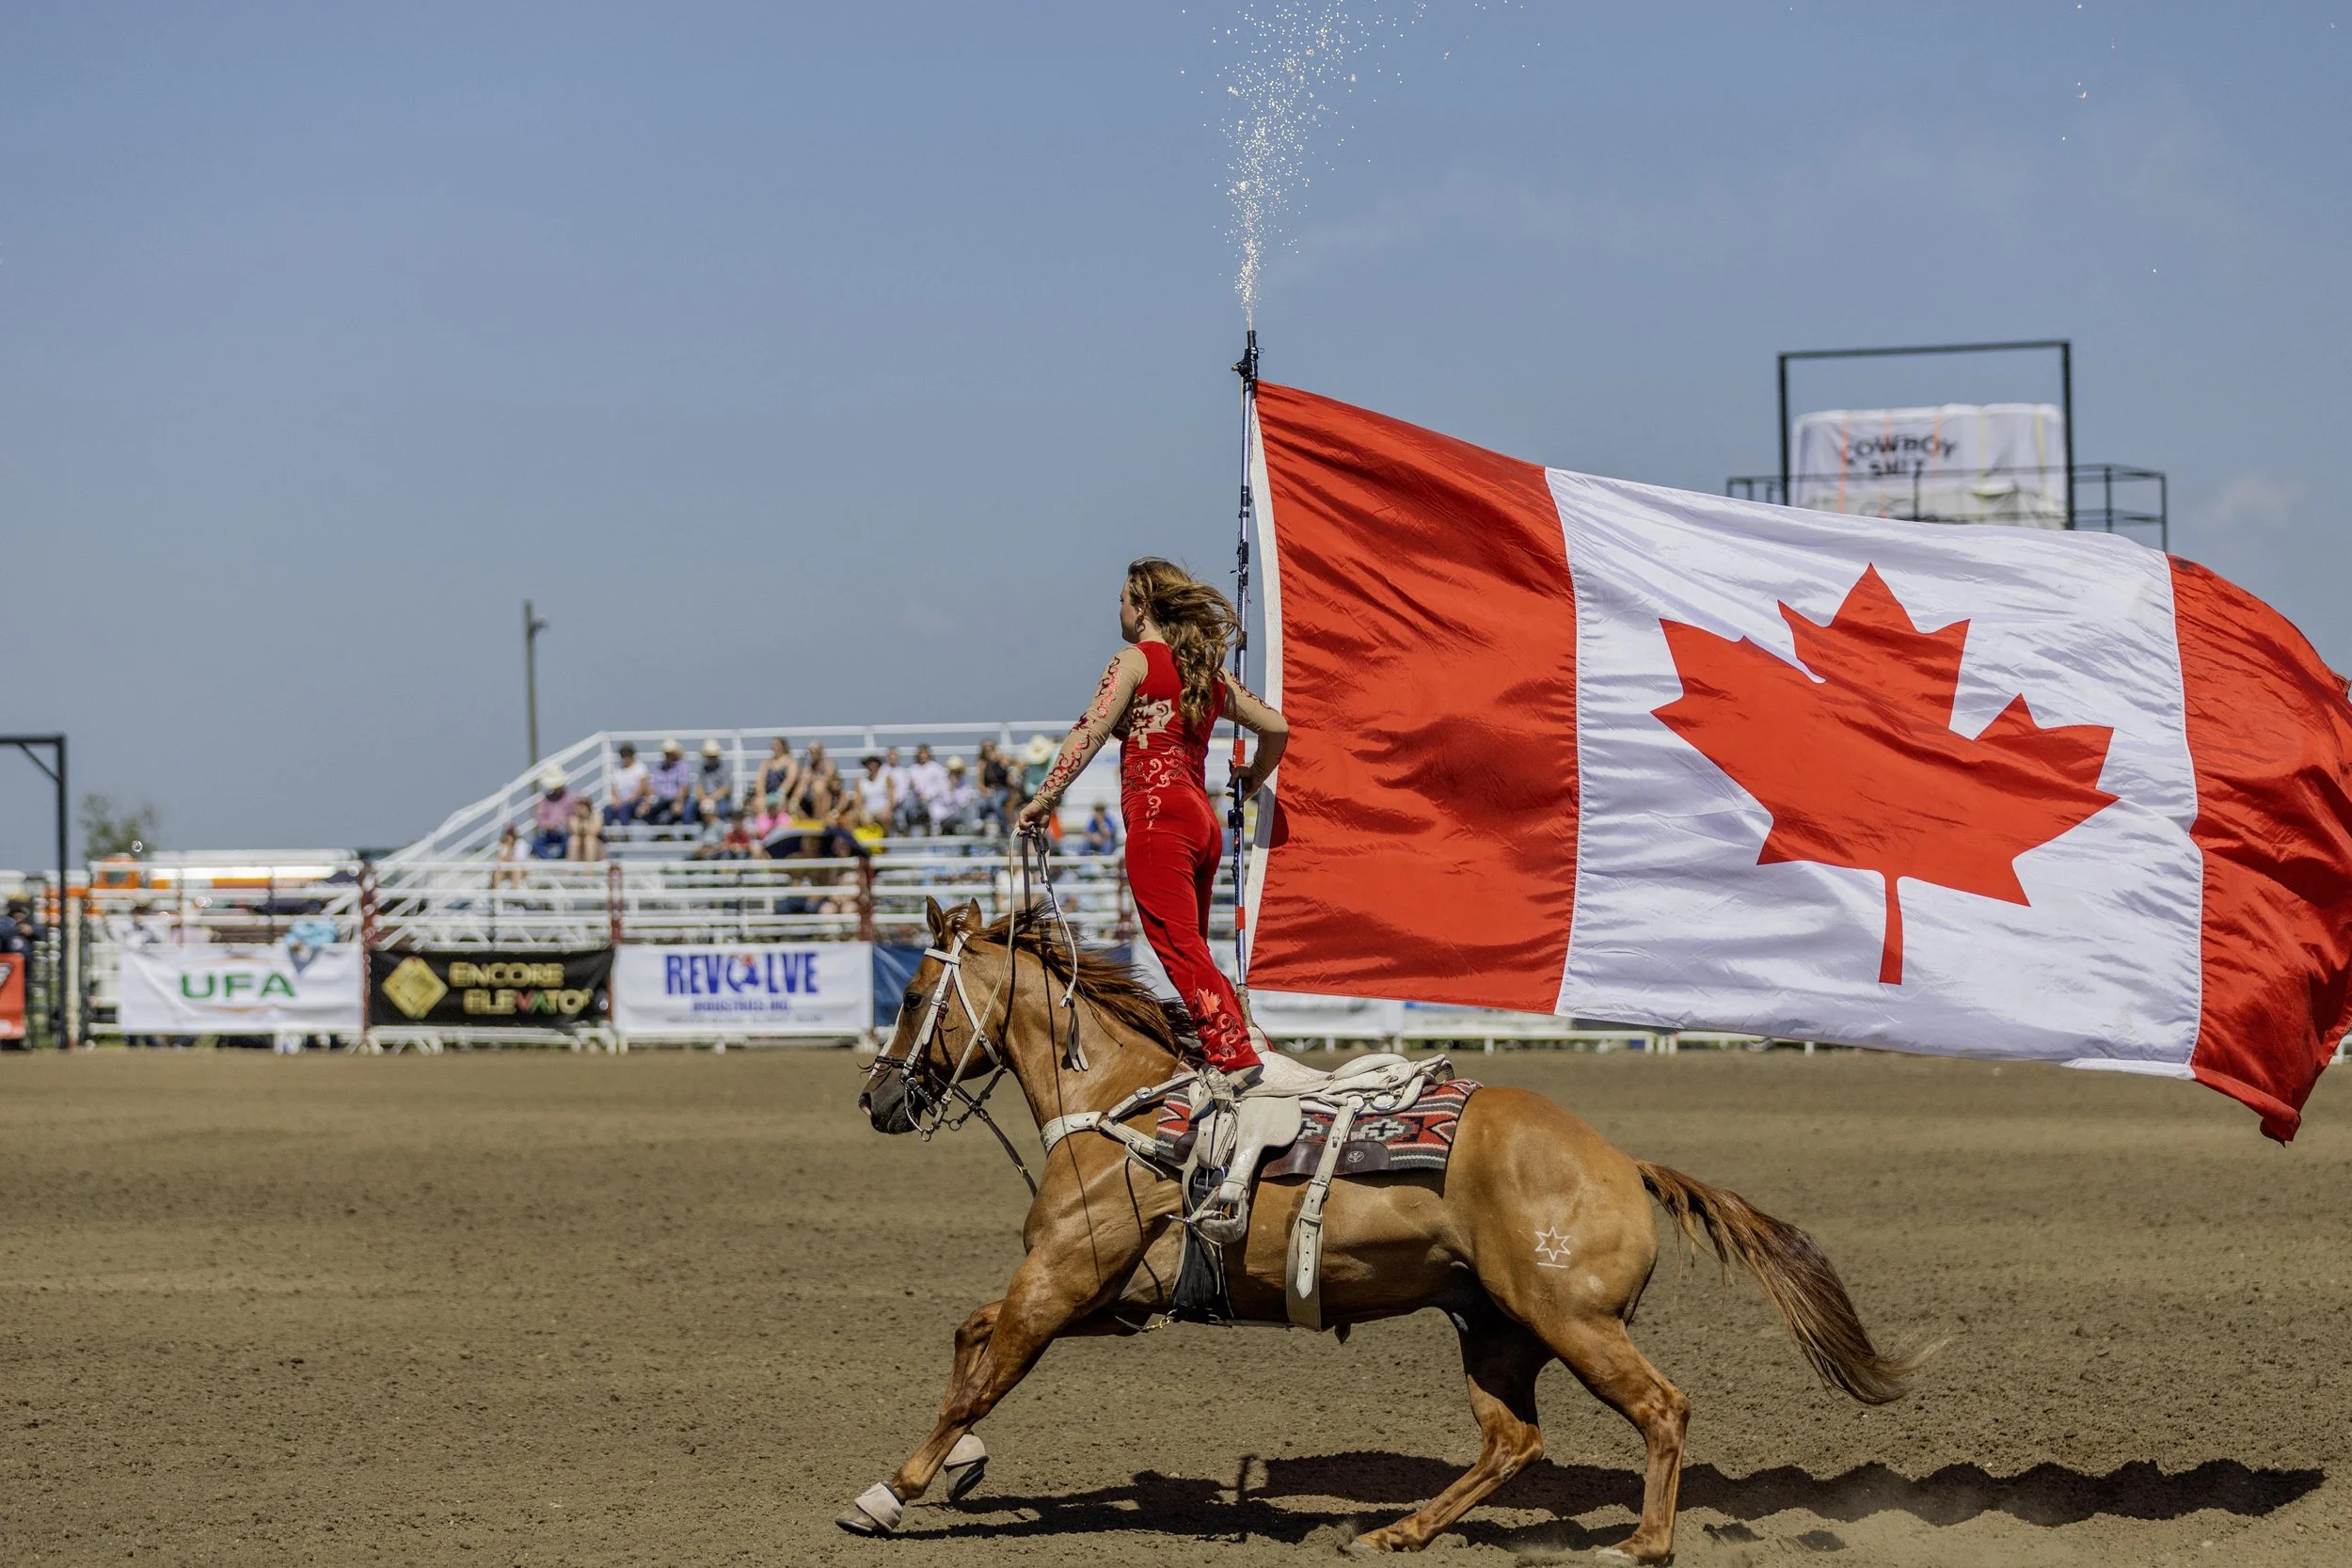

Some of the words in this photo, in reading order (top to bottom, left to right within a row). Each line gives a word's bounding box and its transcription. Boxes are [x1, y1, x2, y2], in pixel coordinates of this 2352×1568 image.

[180, 971, 298, 1000] UFA
[449, 961, 564, 988] ENCORE
[664, 951, 819, 995] REVOLVE
